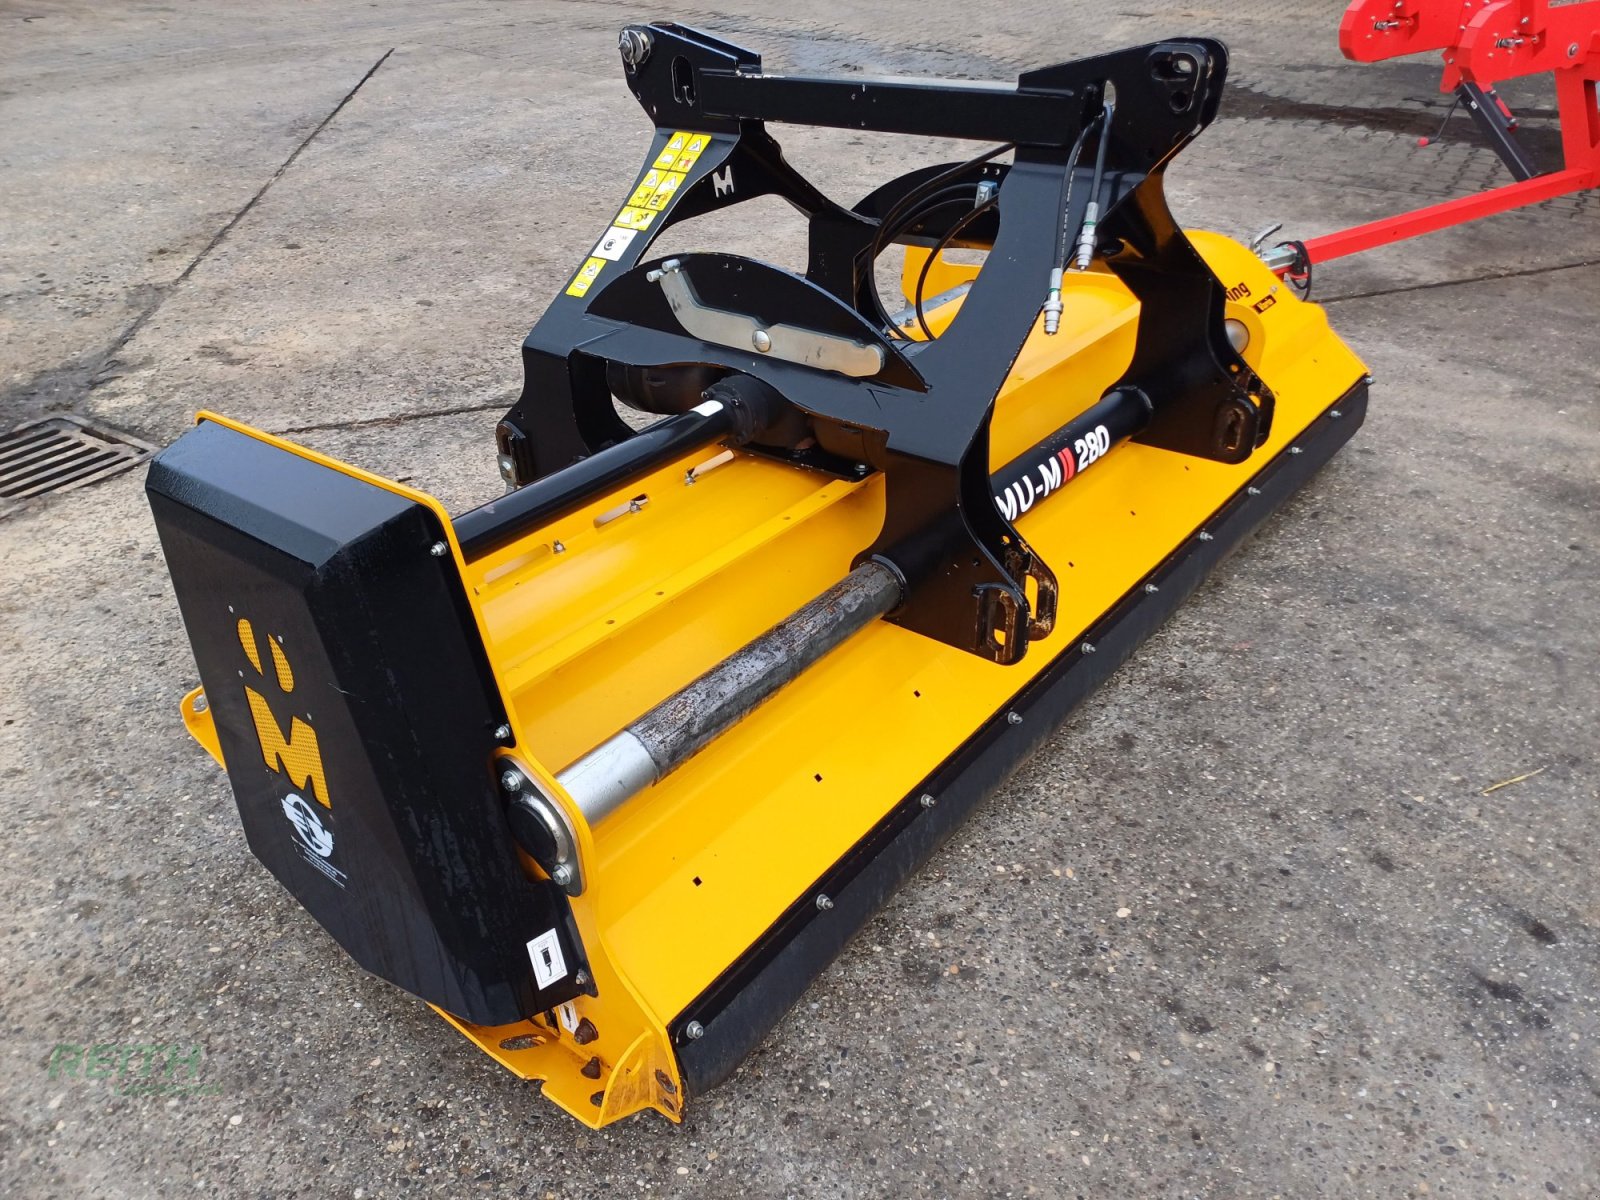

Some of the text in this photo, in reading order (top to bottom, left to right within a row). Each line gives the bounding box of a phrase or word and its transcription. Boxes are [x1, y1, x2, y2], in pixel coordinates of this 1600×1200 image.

[1226, 282, 1252, 302] ing
[995, 424, 1110, 521] MU-M 280
